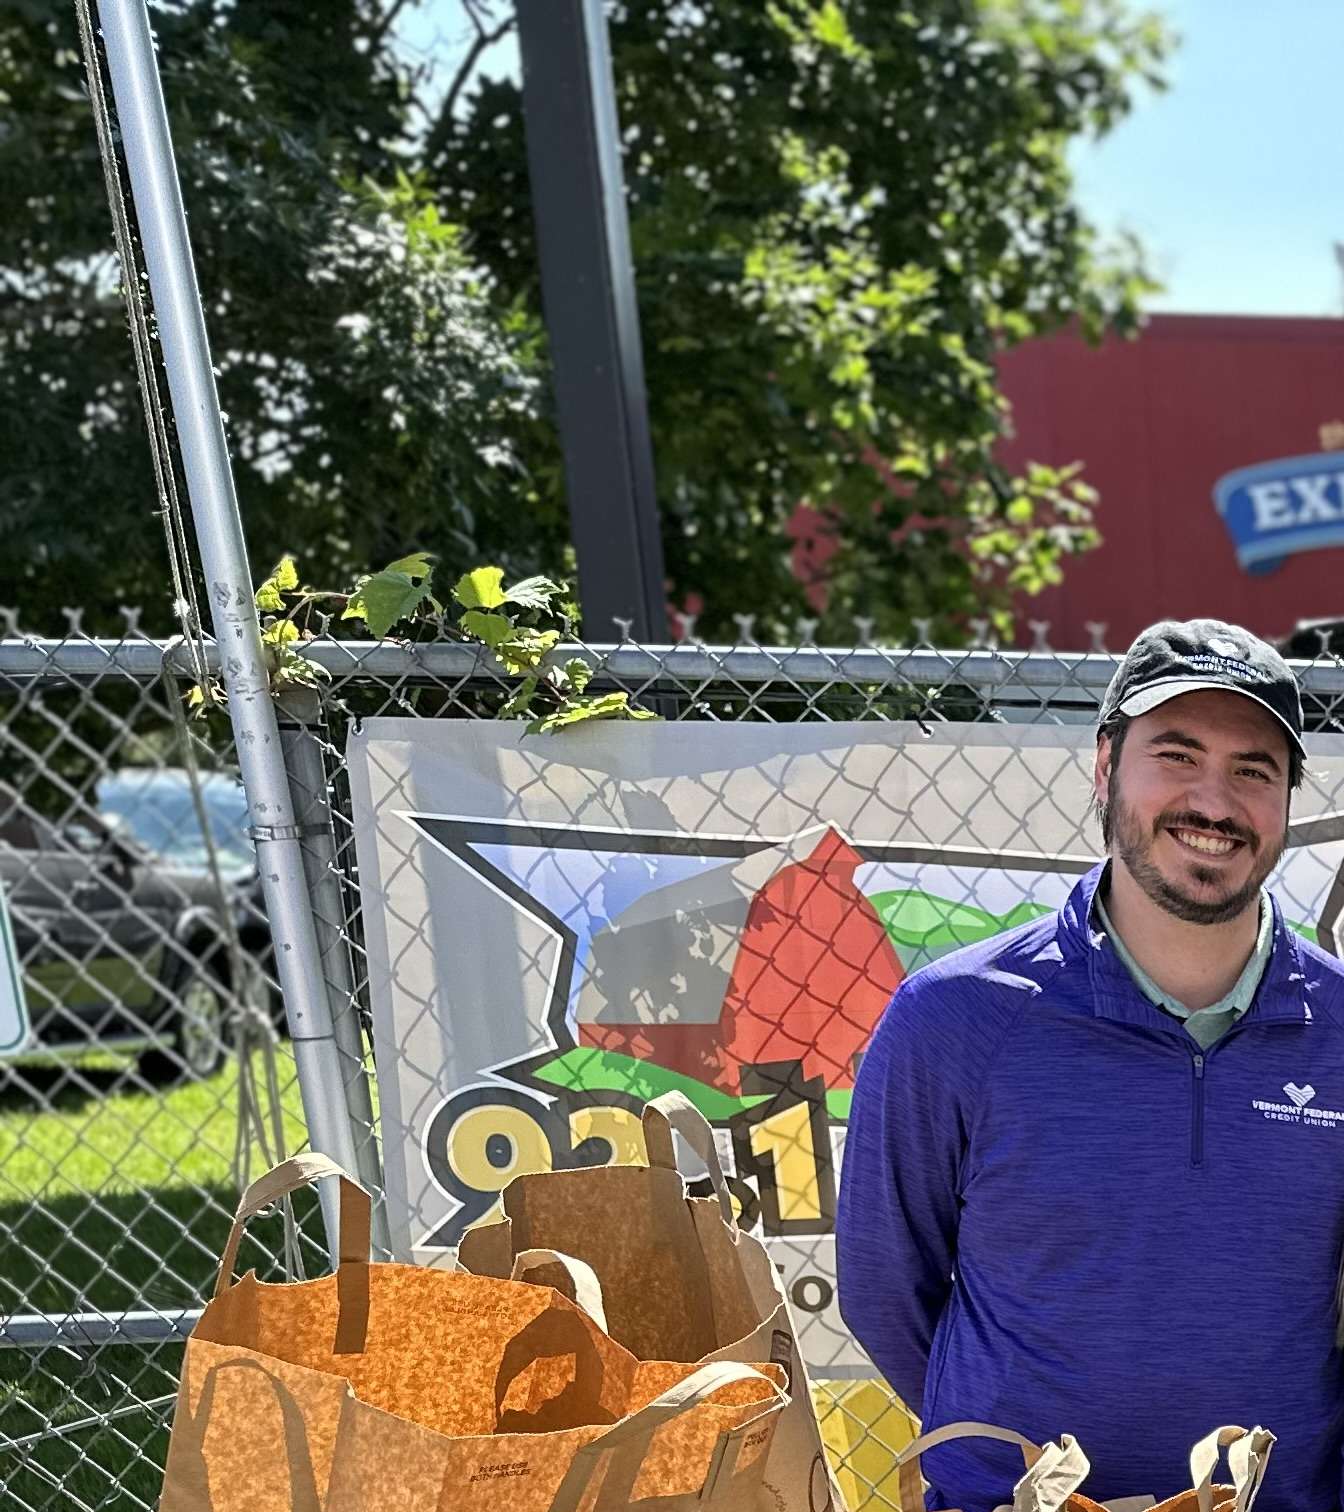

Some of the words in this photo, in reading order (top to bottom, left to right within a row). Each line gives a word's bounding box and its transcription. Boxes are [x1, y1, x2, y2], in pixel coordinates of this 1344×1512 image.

[1252, 1099, 1303, 1115] VERMONT
[1263, 1111, 1300, 1123] CREDIT
[1303, 1117, 1337, 1128] UNION
